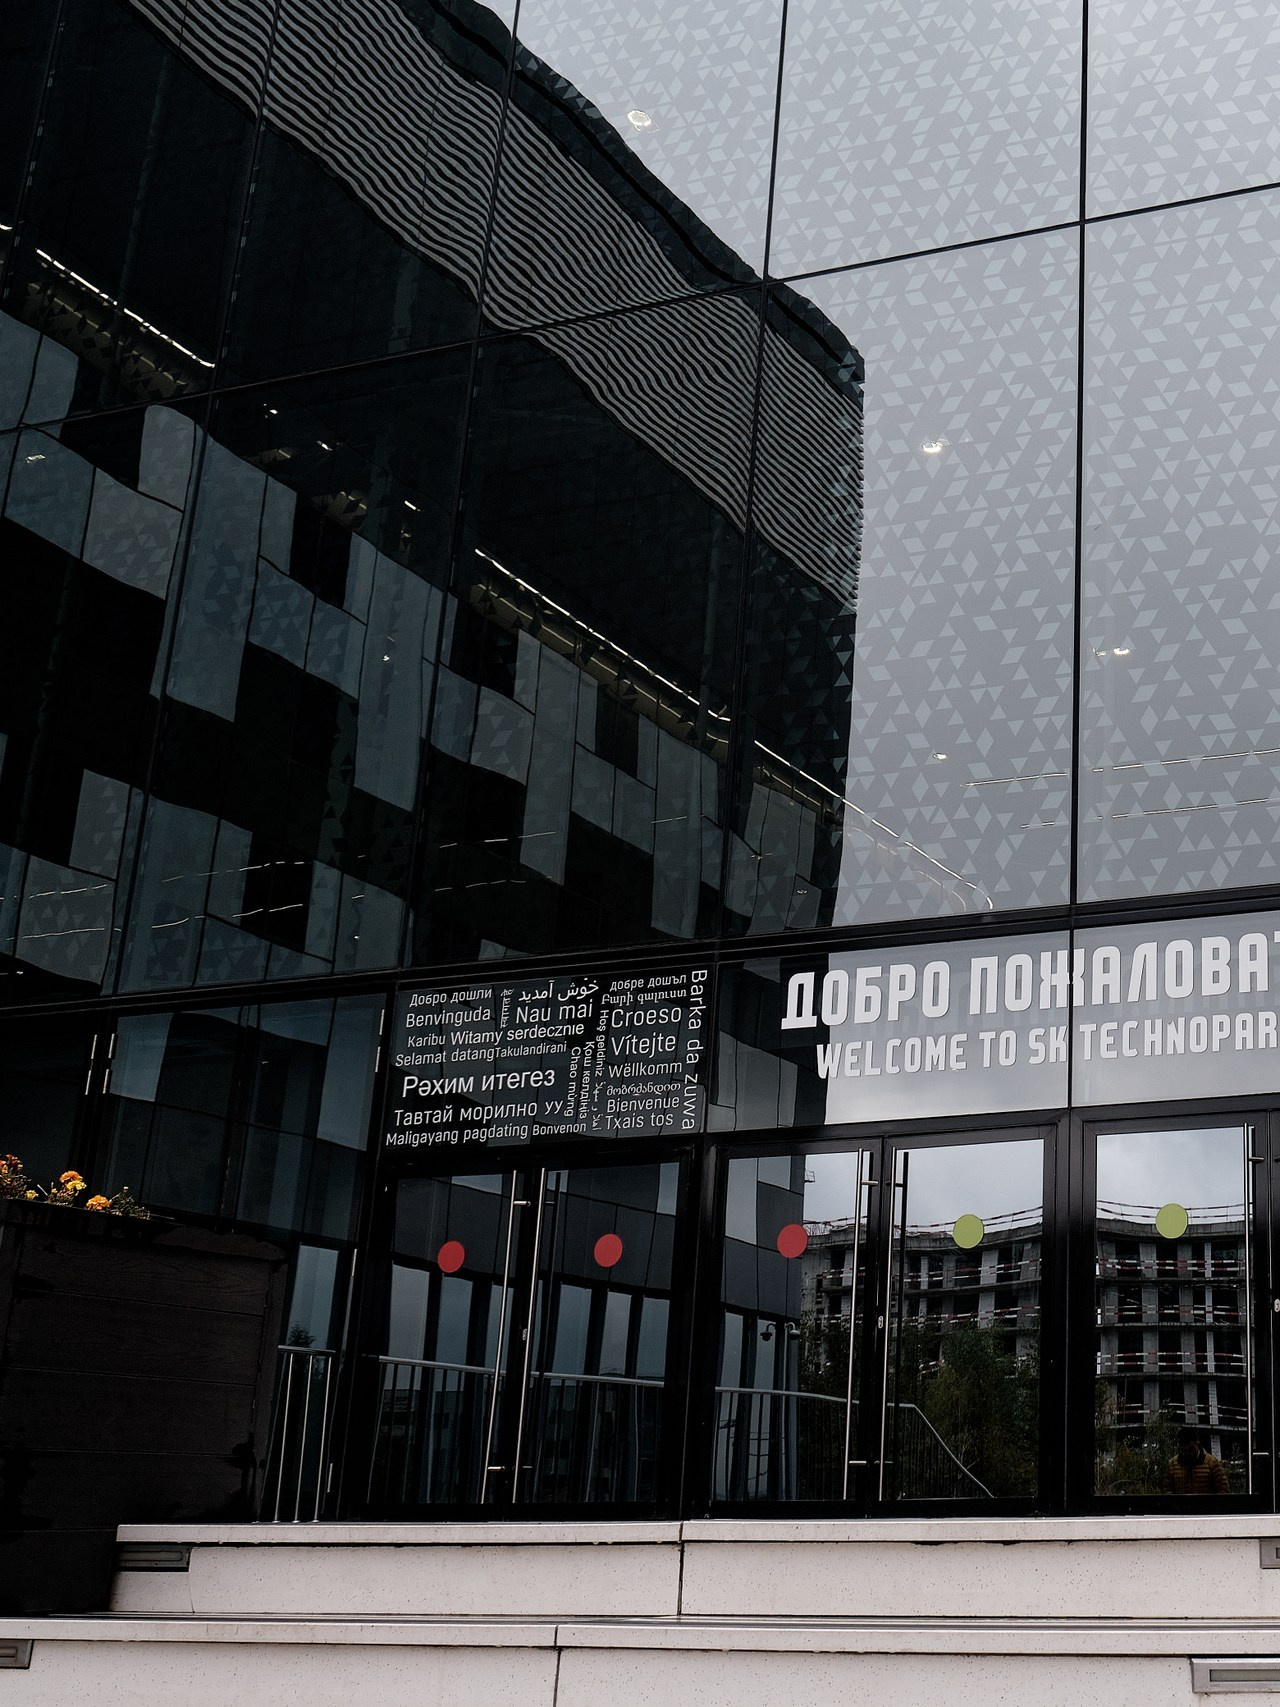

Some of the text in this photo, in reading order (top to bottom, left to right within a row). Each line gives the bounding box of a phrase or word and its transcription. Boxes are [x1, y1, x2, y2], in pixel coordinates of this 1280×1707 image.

[609, 974, 687, 992] добре дошъл
[781, 960, 951, 1030] ДОБРО
[409, 988, 492, 1008] Добро дошли
[516, 998, 593, 1024] Nau mai
[406, 1005, 491, 1028] Benvinguda
[611, 1007, 682, 1028] Croeso
[407, 1023, 585, 1048] Karibu Witamy serdecznie
[594, 1009, 610, 1077] Hoş geldiniz
[611, 1031, 676, 1059] Vítejte
[395, 1041, 567, 1068] Selamat datang Takulandirani
[681, 970, 708, 1130] Barka da zuwa
[816, 1033, 968, 1080] WELCOME
[981, 1029, 1017, 1068] TO
[1028, 1025, 1068, 1064] SK
[608, 1062, 683, 1078] Wëllkomm
[402, 1069, 556, 1098] Рәхим итегез
[394, 1100, 564, 1127] Тавтай морилно уу
[606, 1096, 680, 1113] Bienvenue
[605, 1112, 674, 1130] Txais tos
[385, 1121, 587, 1148] Maligayang pagdating Bonvenon
